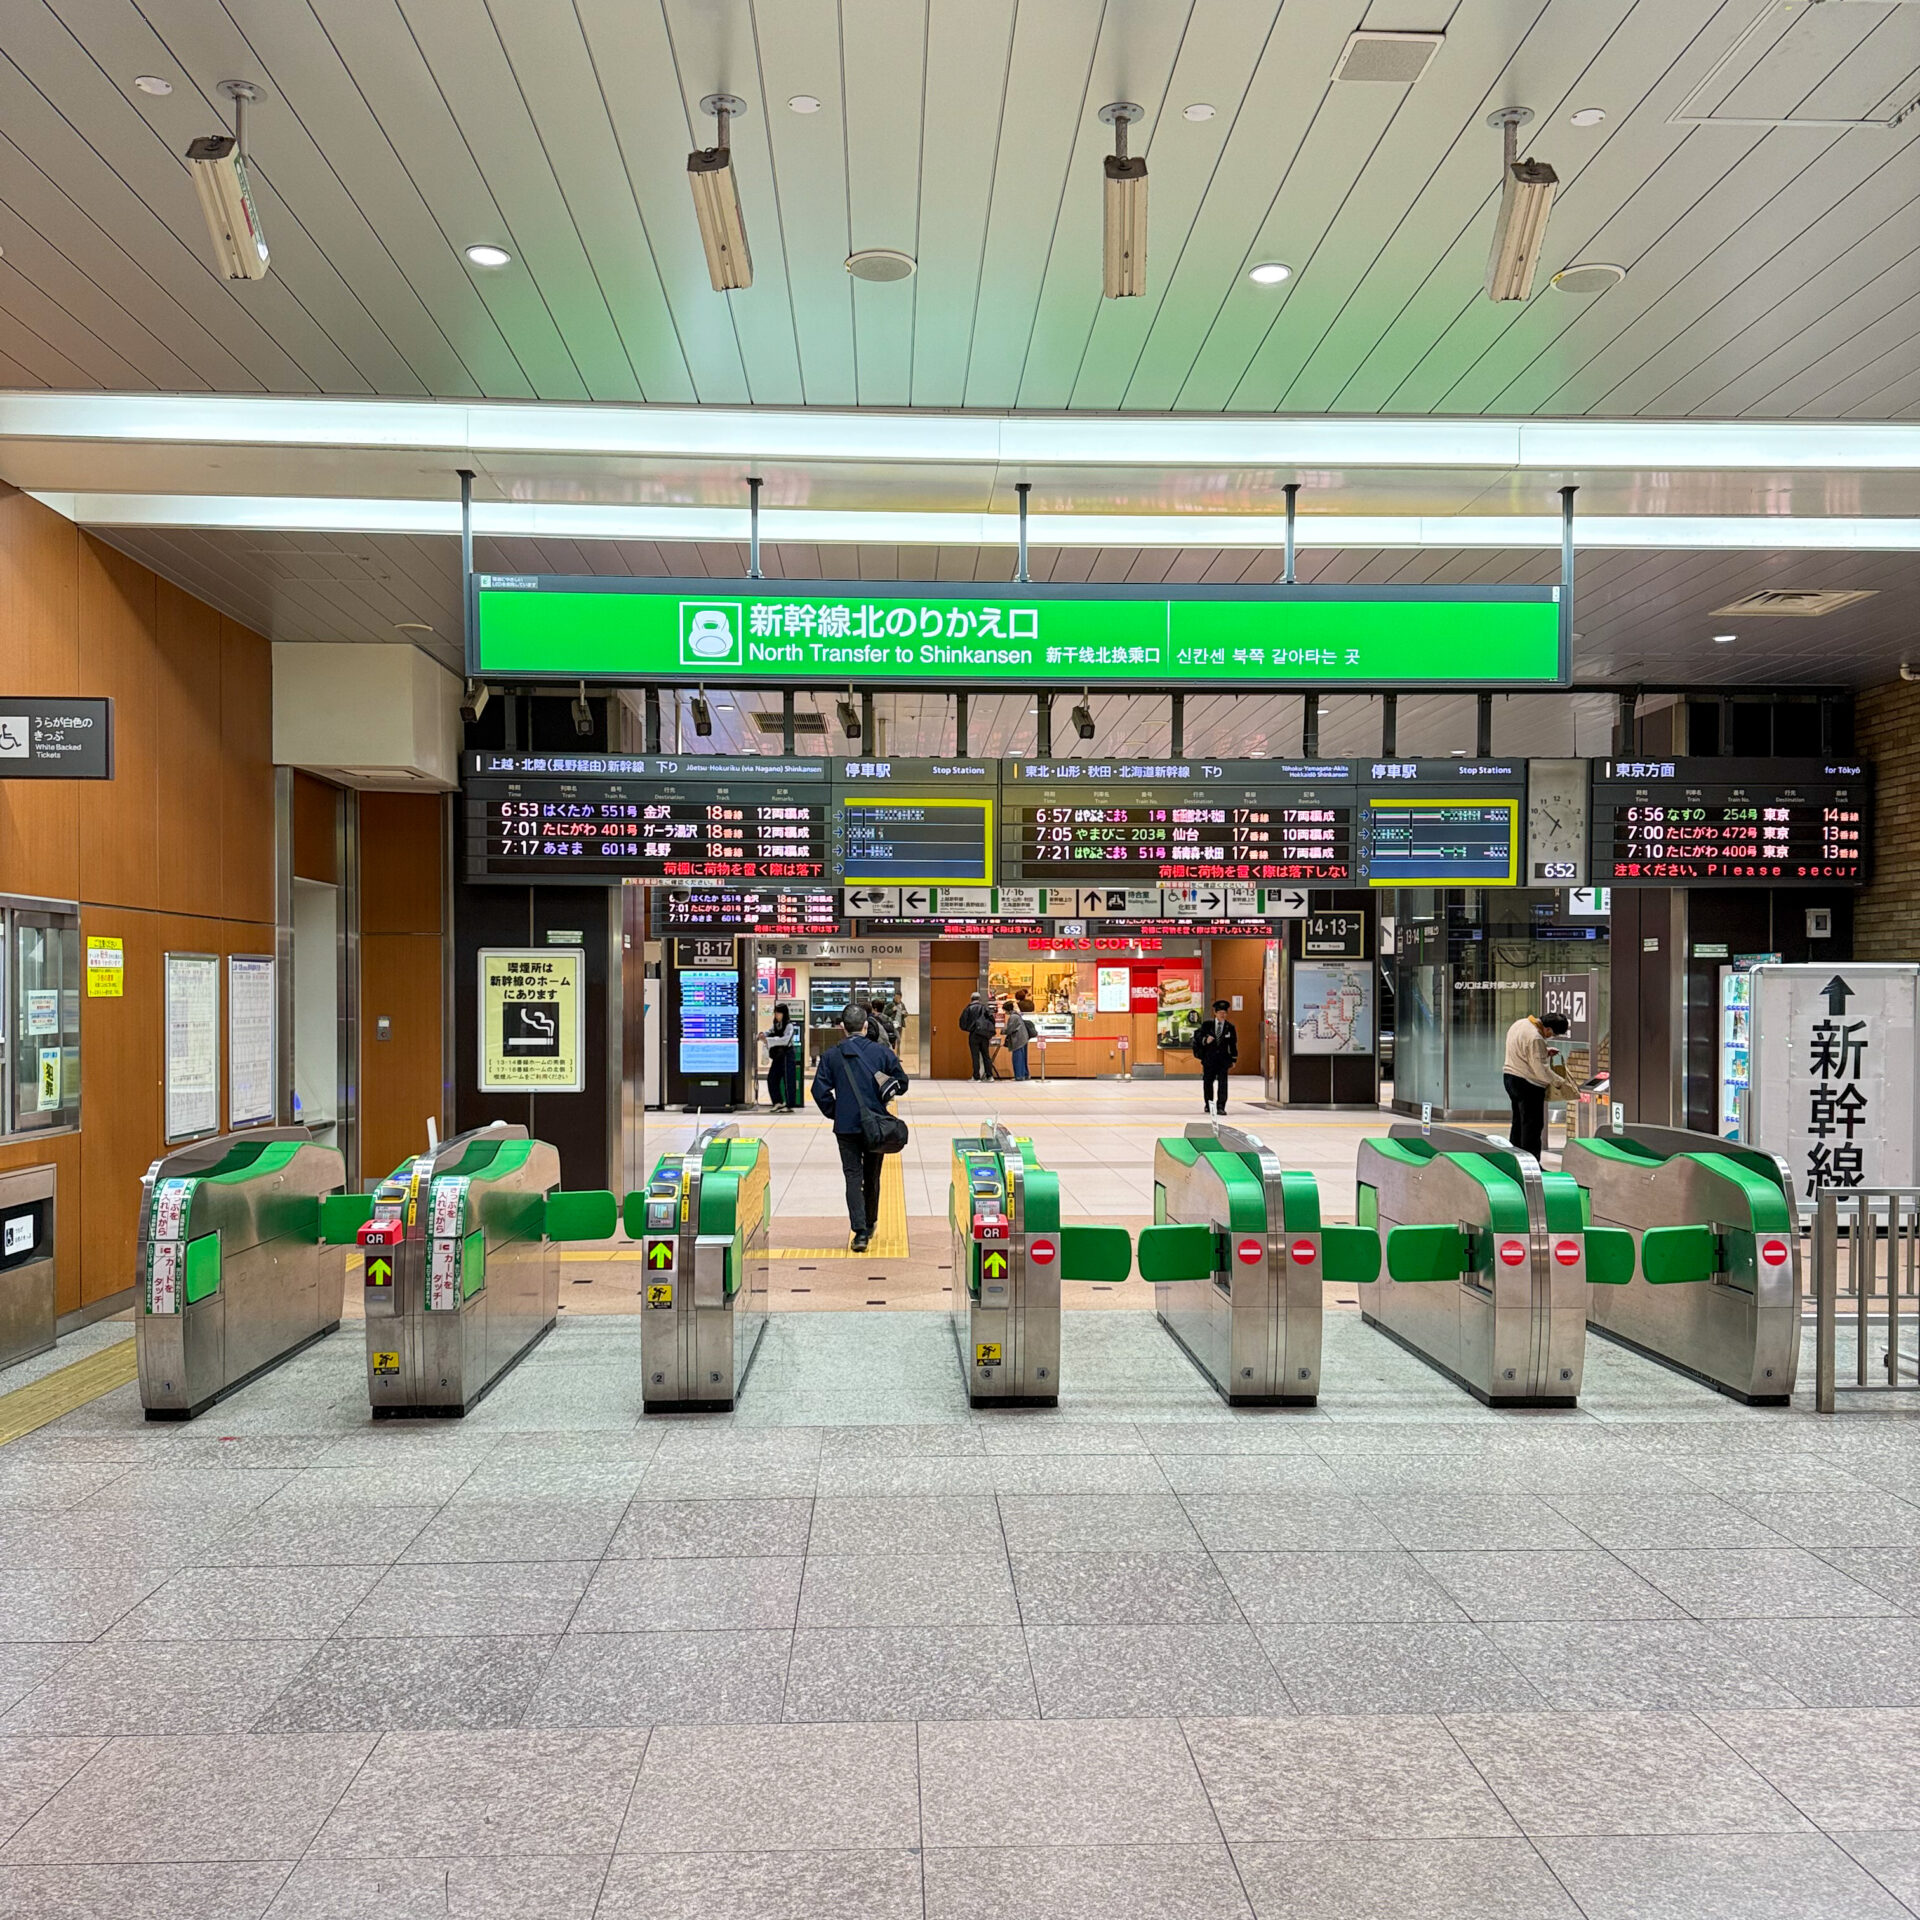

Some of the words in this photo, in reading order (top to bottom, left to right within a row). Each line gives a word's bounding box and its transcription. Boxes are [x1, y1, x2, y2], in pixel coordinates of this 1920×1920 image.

[750, 603, 1039, 639] 新幹線北のりかえ口
[749, 643, 803, 661] North
[809, 643, 890, 662] Transfer
[895, 646, 914, 663] to
[919, 646, 1033, 664] Shinkansen
[1046, 646, 1160, 664] 新干线北换乘口
[1176, 648, 1225, 665] 신칸센
[1232, 648, 1266, 665] 북쪽
[1271, 648, 1338, 665] 갈아타는
[1344, 649, 1361, 665] 곳
[34, 716, 93, 728] うらが白色の
[34, 730, 64, 741] きっぷ
[56, 743, 82, 751] Backed
[36, 751, 61, 759] Tickets
[656, 761, 678, 773] 下り
[784, 765, 822, 773] Shinkansen
[845, 763, 891, 778] 停車駅
[932, 766, 952, 776] Stop
[952, 766, 985, 775] Stations
[1201, 766, 1223, 778] 下り
[1371, 764, 1417, 779] 停車駅
[1458, 766, 1478, 776] Stop
[1478, 766, 1512, 775] Stations
[1615, 763, 1676, 778] 東京方面
[1824, 766, 1836, 774] for
[501, 803, 539, 817] 6:53
[543, 804, 594, 817] はくたか
[601, 805, 637, 817] 551号
[643, 805, 671, 819] 金沢
[1036, 808, 1072, 823] 6:57
[1149, 810, 1167, 822] 1号
[1627, 807, 1664, 821] 6:56
[1666, 808, 1706, 821] なすの
[1723, 808, 1758, 820] 254号
[1763, 807, 1790, 821] 東京
[501, 821, 537, 836] 7:01
[542, 822, 597, 836] たにがわ
[601, 823, 638, 836] 401号
[643, 824, 698, 838] ガーラ湯沢
[1036, 827, 1072, 841] 7:05
[1075, 828, 1126, 840] やまびこ
[1131, 828, 1167, 840] 203号
[1172, 827, 1200, 842] 仙台
[1627, 825, 1664, 840] 7:00
[1666, 826, 1719, 839] たにがわ
[1722, 827, 1757, 839] 472号
[1763, 826, 1790, 840] 東京
[501, 840, 540, 855] 7:17
[543, 841, 583, 855] あさま
[601, 842, 638, 855] 601号
[643, 842, 671, 857] 長野
[1036, 845, 1070, 860] 7:21
[1138, 847, 1167, 859] 51号
[1627, 844, 1663, 858] 7:10
[1666, 845, 1718, 858] たにがわ
[1722, 845, 1757, 858] 400号
[1762, 845, 1790, 859] 東京
[1614, 863, 1697, 877] 注意ください。
[1708, 864, 1781, 876] Please
[1798, 866, 1857, 876] secur
[766, 944, 808, 955] 待合室
[819, 945, 865, 954] WAITING
[871, 945, 903, 954] ROOM
[1094, 937, 1162, 950] COFFEE
[507, 962, 553, 974] 喫煙所は
[490, 975, 571, 987] 新幹線のホーム
[504, 989, 558, 1000] にあります
[1423, 1106, 1429, 1121] 5
[1615, 1107, 1621, 1120] 6
[1805, 1018, 1869, 1202] 新幹線
[170, 1189, 181, 1221] きっぷを
[447, 1187, 458, 1219] きっぷを
[157, 1193, 170, 1236] 入れてから
[435, 1191, 446, 1234] 入れてから
[366, 1233, 384, 1244] QR
[983, 1228, 1000, 1238] QR
[165, 1259, 174, 1293] カードを
[444, 1255, 453, 1290] カードを
[656, 1374, 662, 1383] 2
[712, 1373, 719, 1382] 3
[984, 1370, 991, 1378] 3
[1039, 1370, 1045, 1378] 4
[1245, 1369, 1251, 1377] 4
[1301, 1370, 1307, 1378] 5
[1507, 1371, 1513, 1379] 5
[1562, 1370, 1568, 1379] 6
[1766, 1369, 1772, 1378] 6
[165, 1382, 171, 1391] 1
